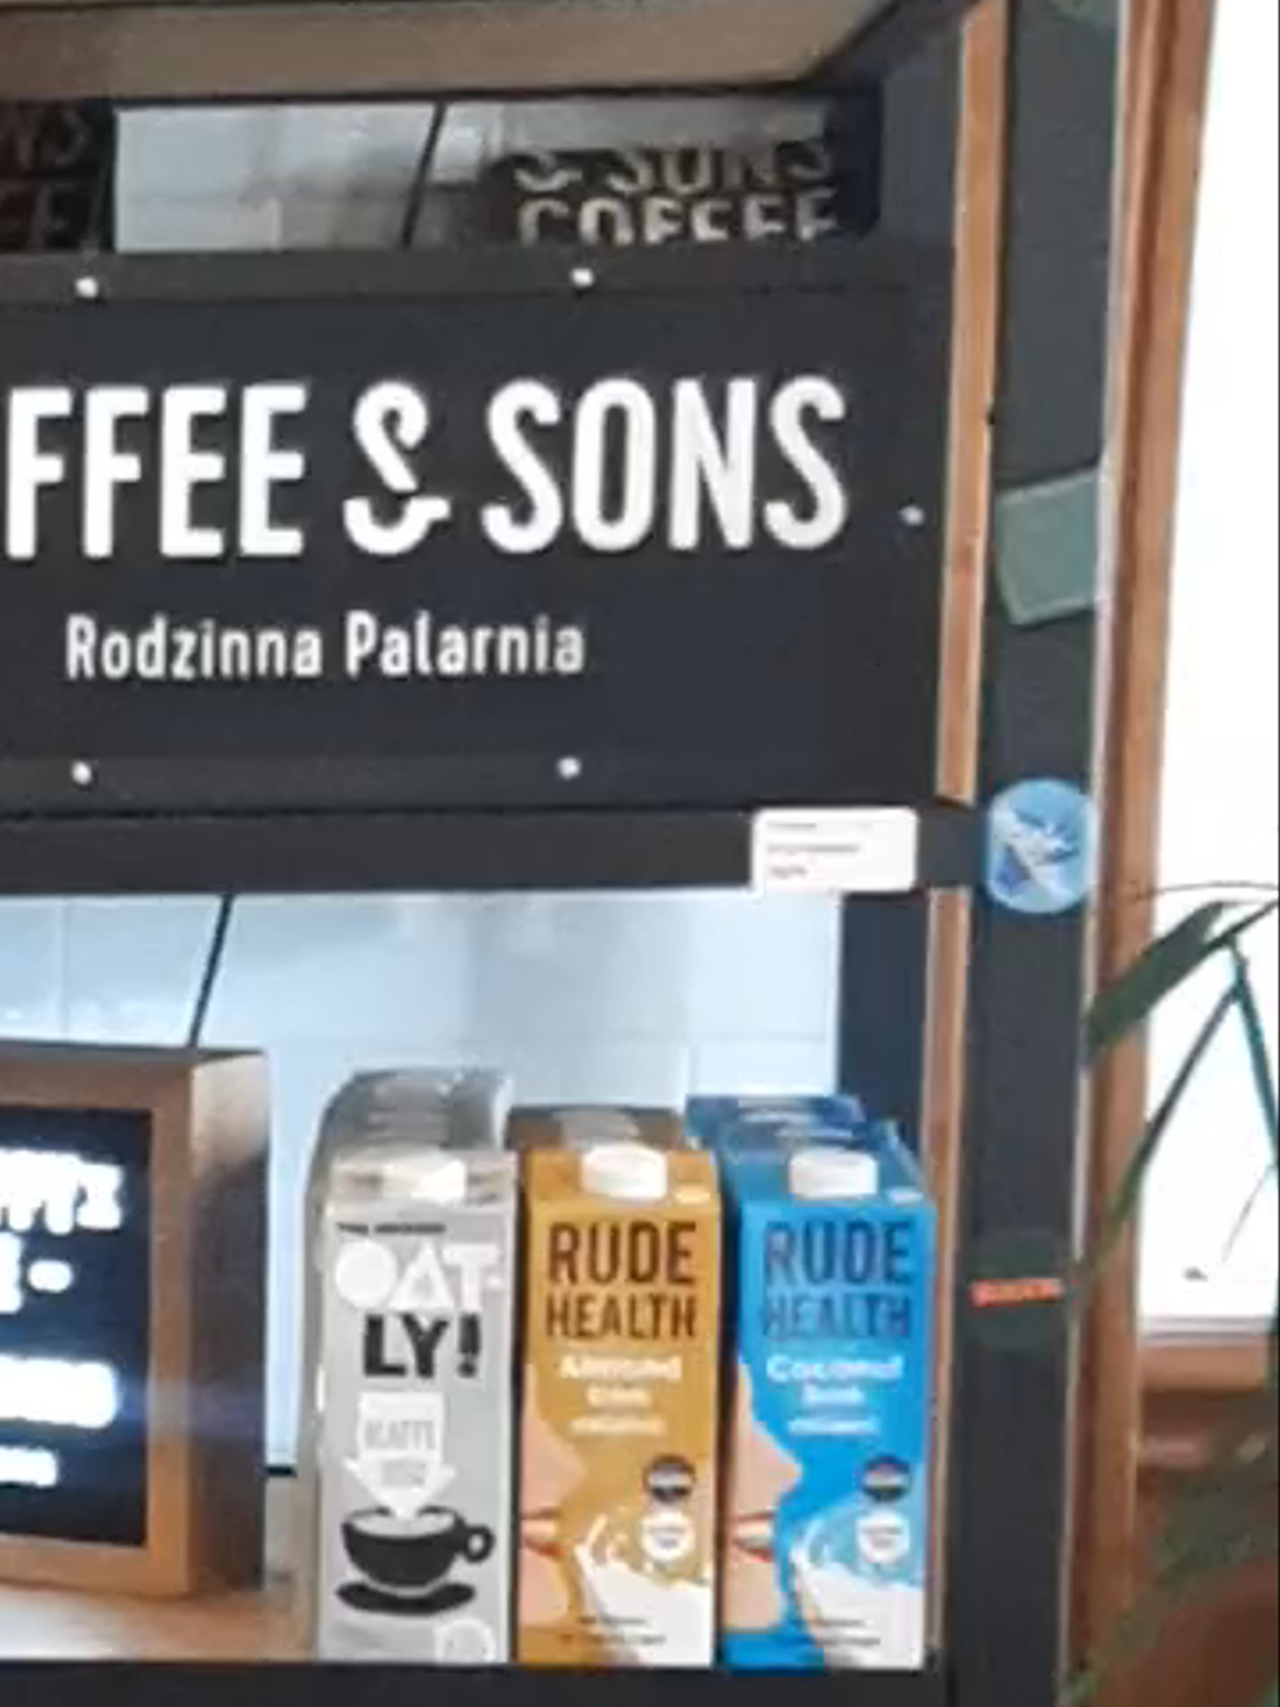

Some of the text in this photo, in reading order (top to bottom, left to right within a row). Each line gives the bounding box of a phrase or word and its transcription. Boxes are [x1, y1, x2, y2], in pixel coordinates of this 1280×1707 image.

[479, 373, 850, 555] SONS
[63, 608, 587, 684] Rodzinna Palarnia
[549, 1222, 697, 1285] RUDE
[764, 1221, 911, 1286] RUDE
[363, 1313, 481, 1379] LY!
[546, 1294, 696, 1339] HEALTH
[764, 1294, 912, 1340] HEALTH
